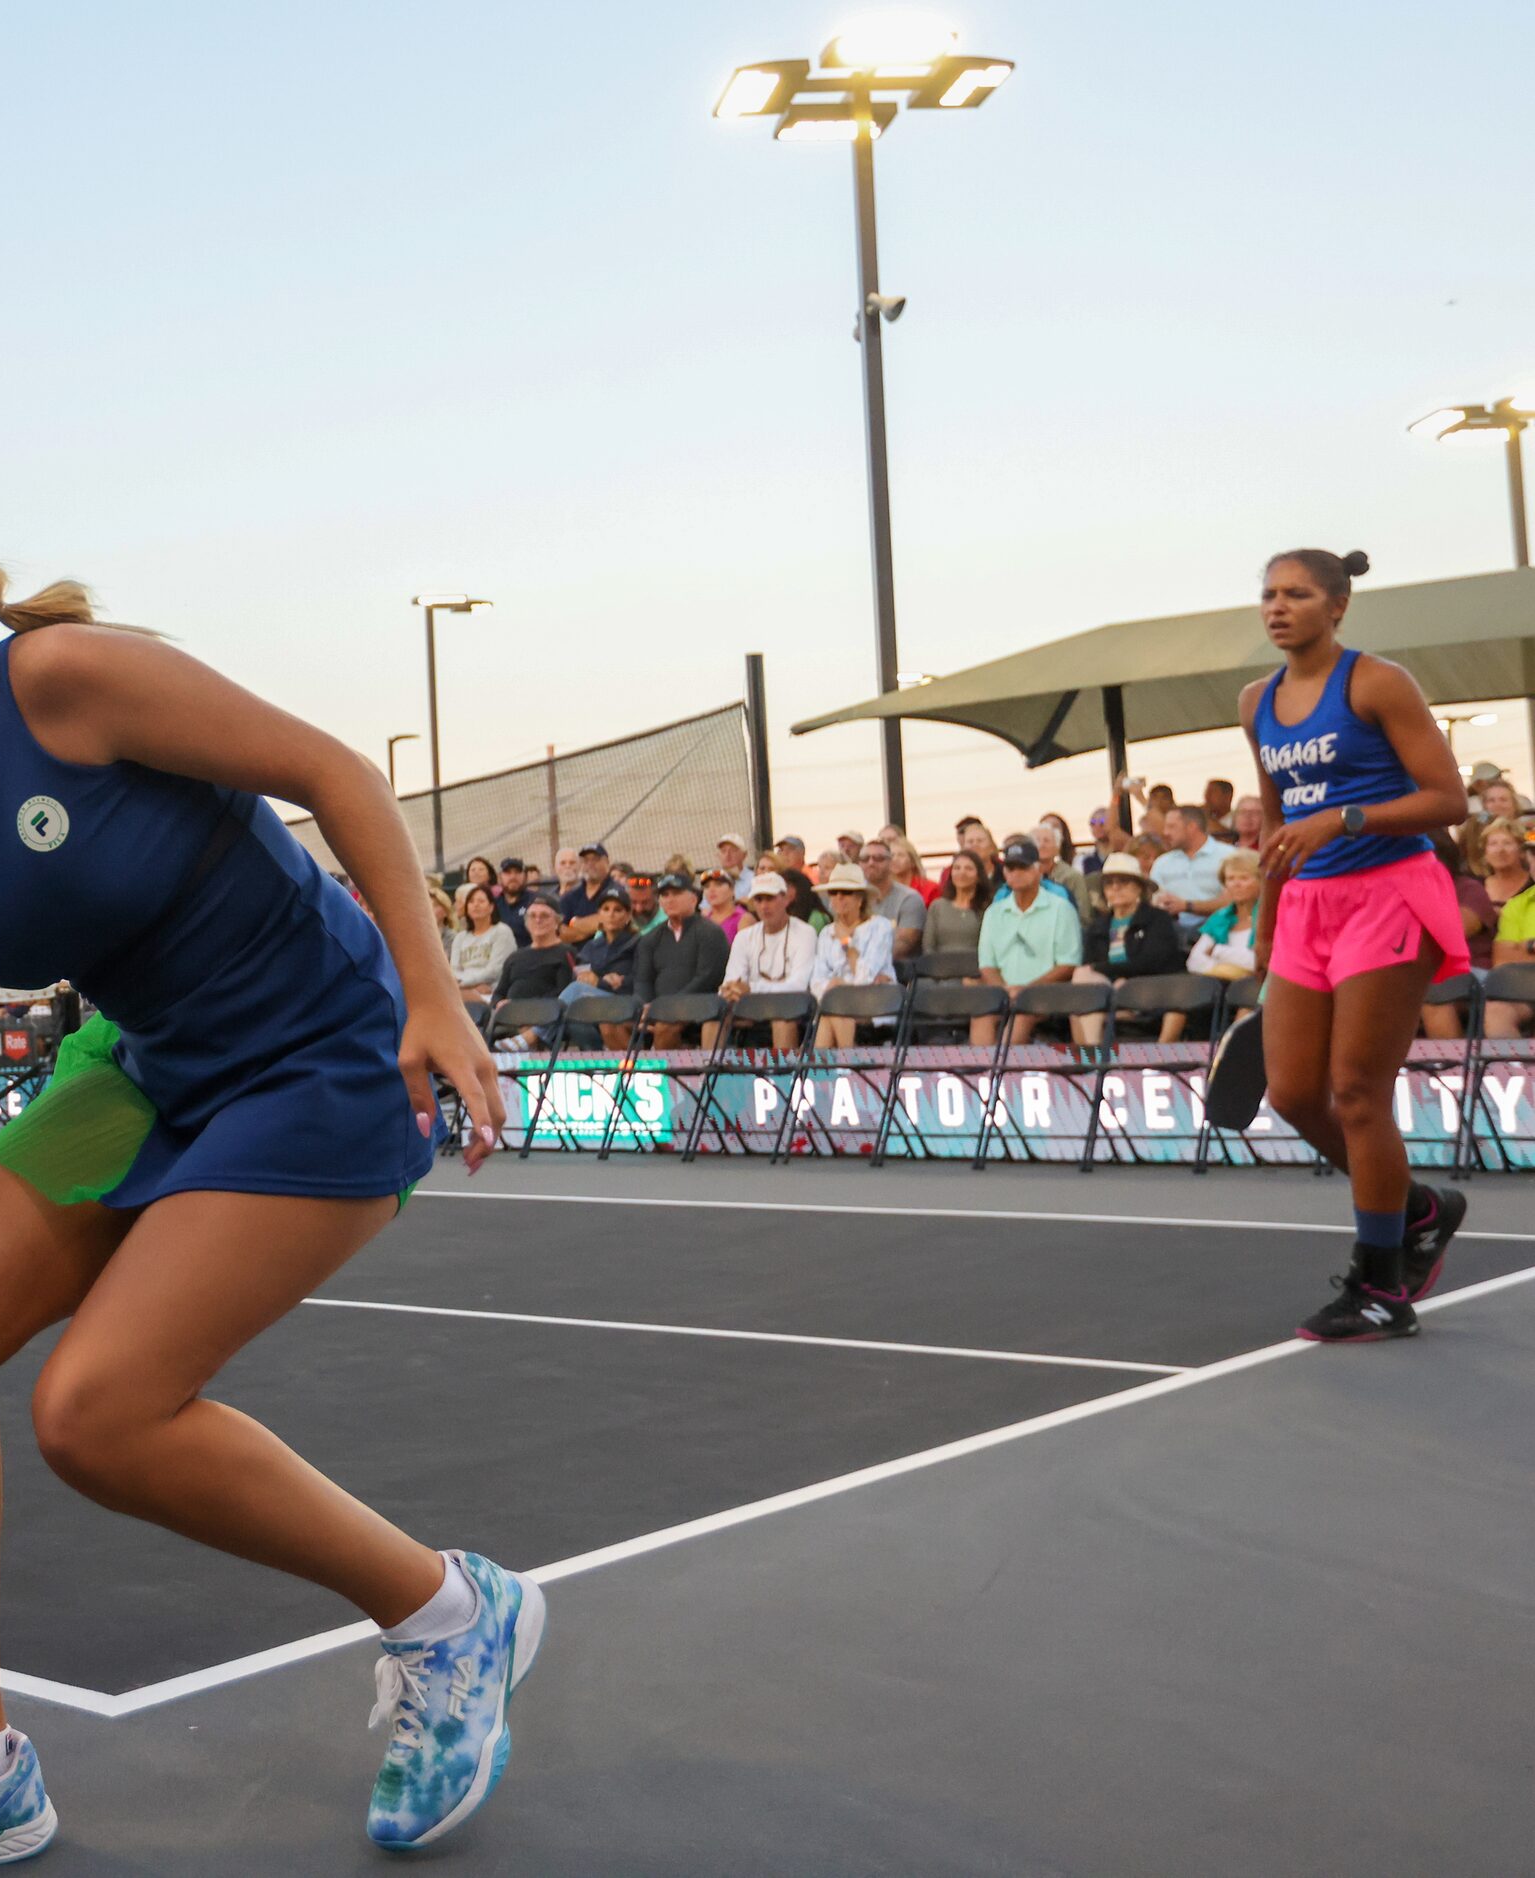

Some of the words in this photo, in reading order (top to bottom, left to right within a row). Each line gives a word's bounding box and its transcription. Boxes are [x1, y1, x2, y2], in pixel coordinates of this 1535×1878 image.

[5, 1034, 28, 1050] Rate
[753, 1076, 860, 1127] PPA
[898, 1076, 1051, 1128] TOUR
